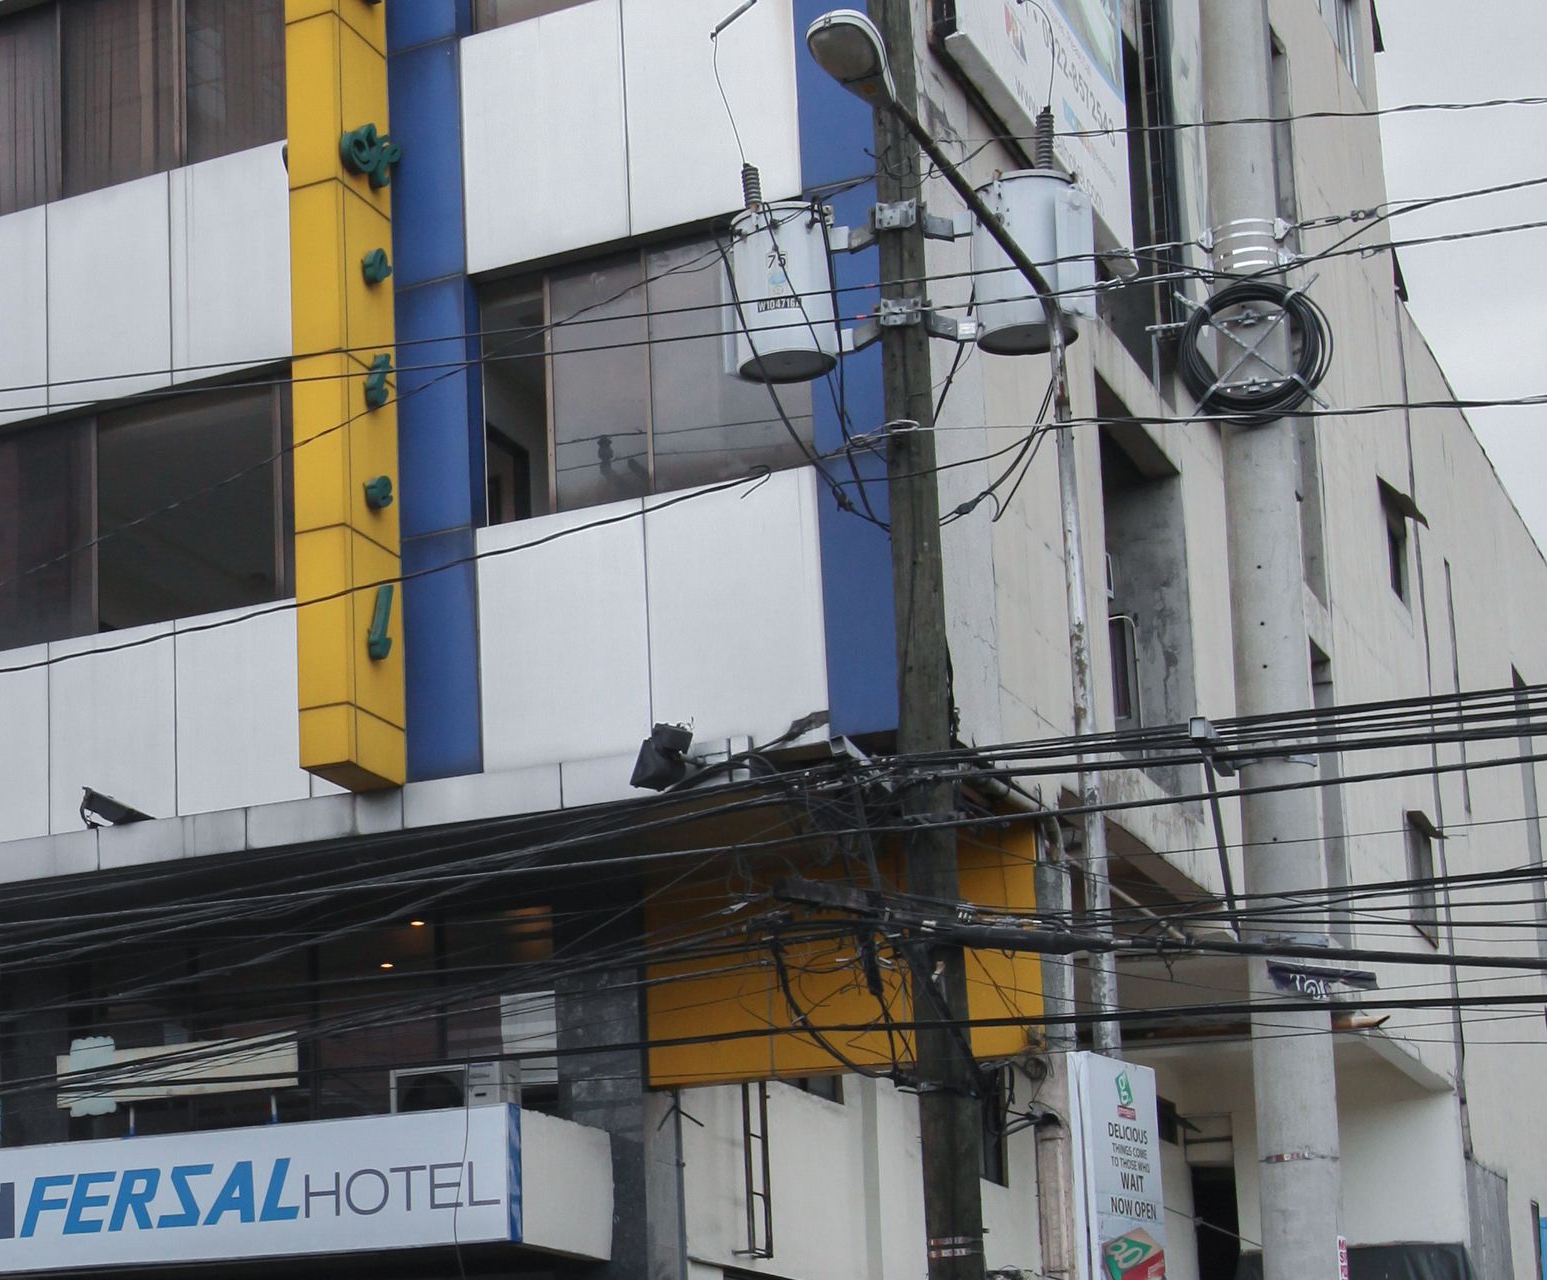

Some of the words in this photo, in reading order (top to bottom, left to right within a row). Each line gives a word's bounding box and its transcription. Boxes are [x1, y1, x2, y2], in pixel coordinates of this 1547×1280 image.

[768, 253, 787, 269] 75
[1108, 1122, 1148, 1145] DELICIOUS
[1112, 1143, 1132, 1156] THINGS
[1133, 1147, 1148, 1160] COME
[1111, 1156, 1119, 1167] TO
[1120, 1158, 1137, 1170] THOSE
[1138, 1161, 1150, 1173] WHO
[1120, 1172, 1144, 1193] WAIT
[19, 1157, 301, 1239] FERSAL
[304, 1161, 501, 1219] HOTEL
[1111, 1197, 1133, 1216] NOW
[1134, 1200, 1157, 1220] OPEN
